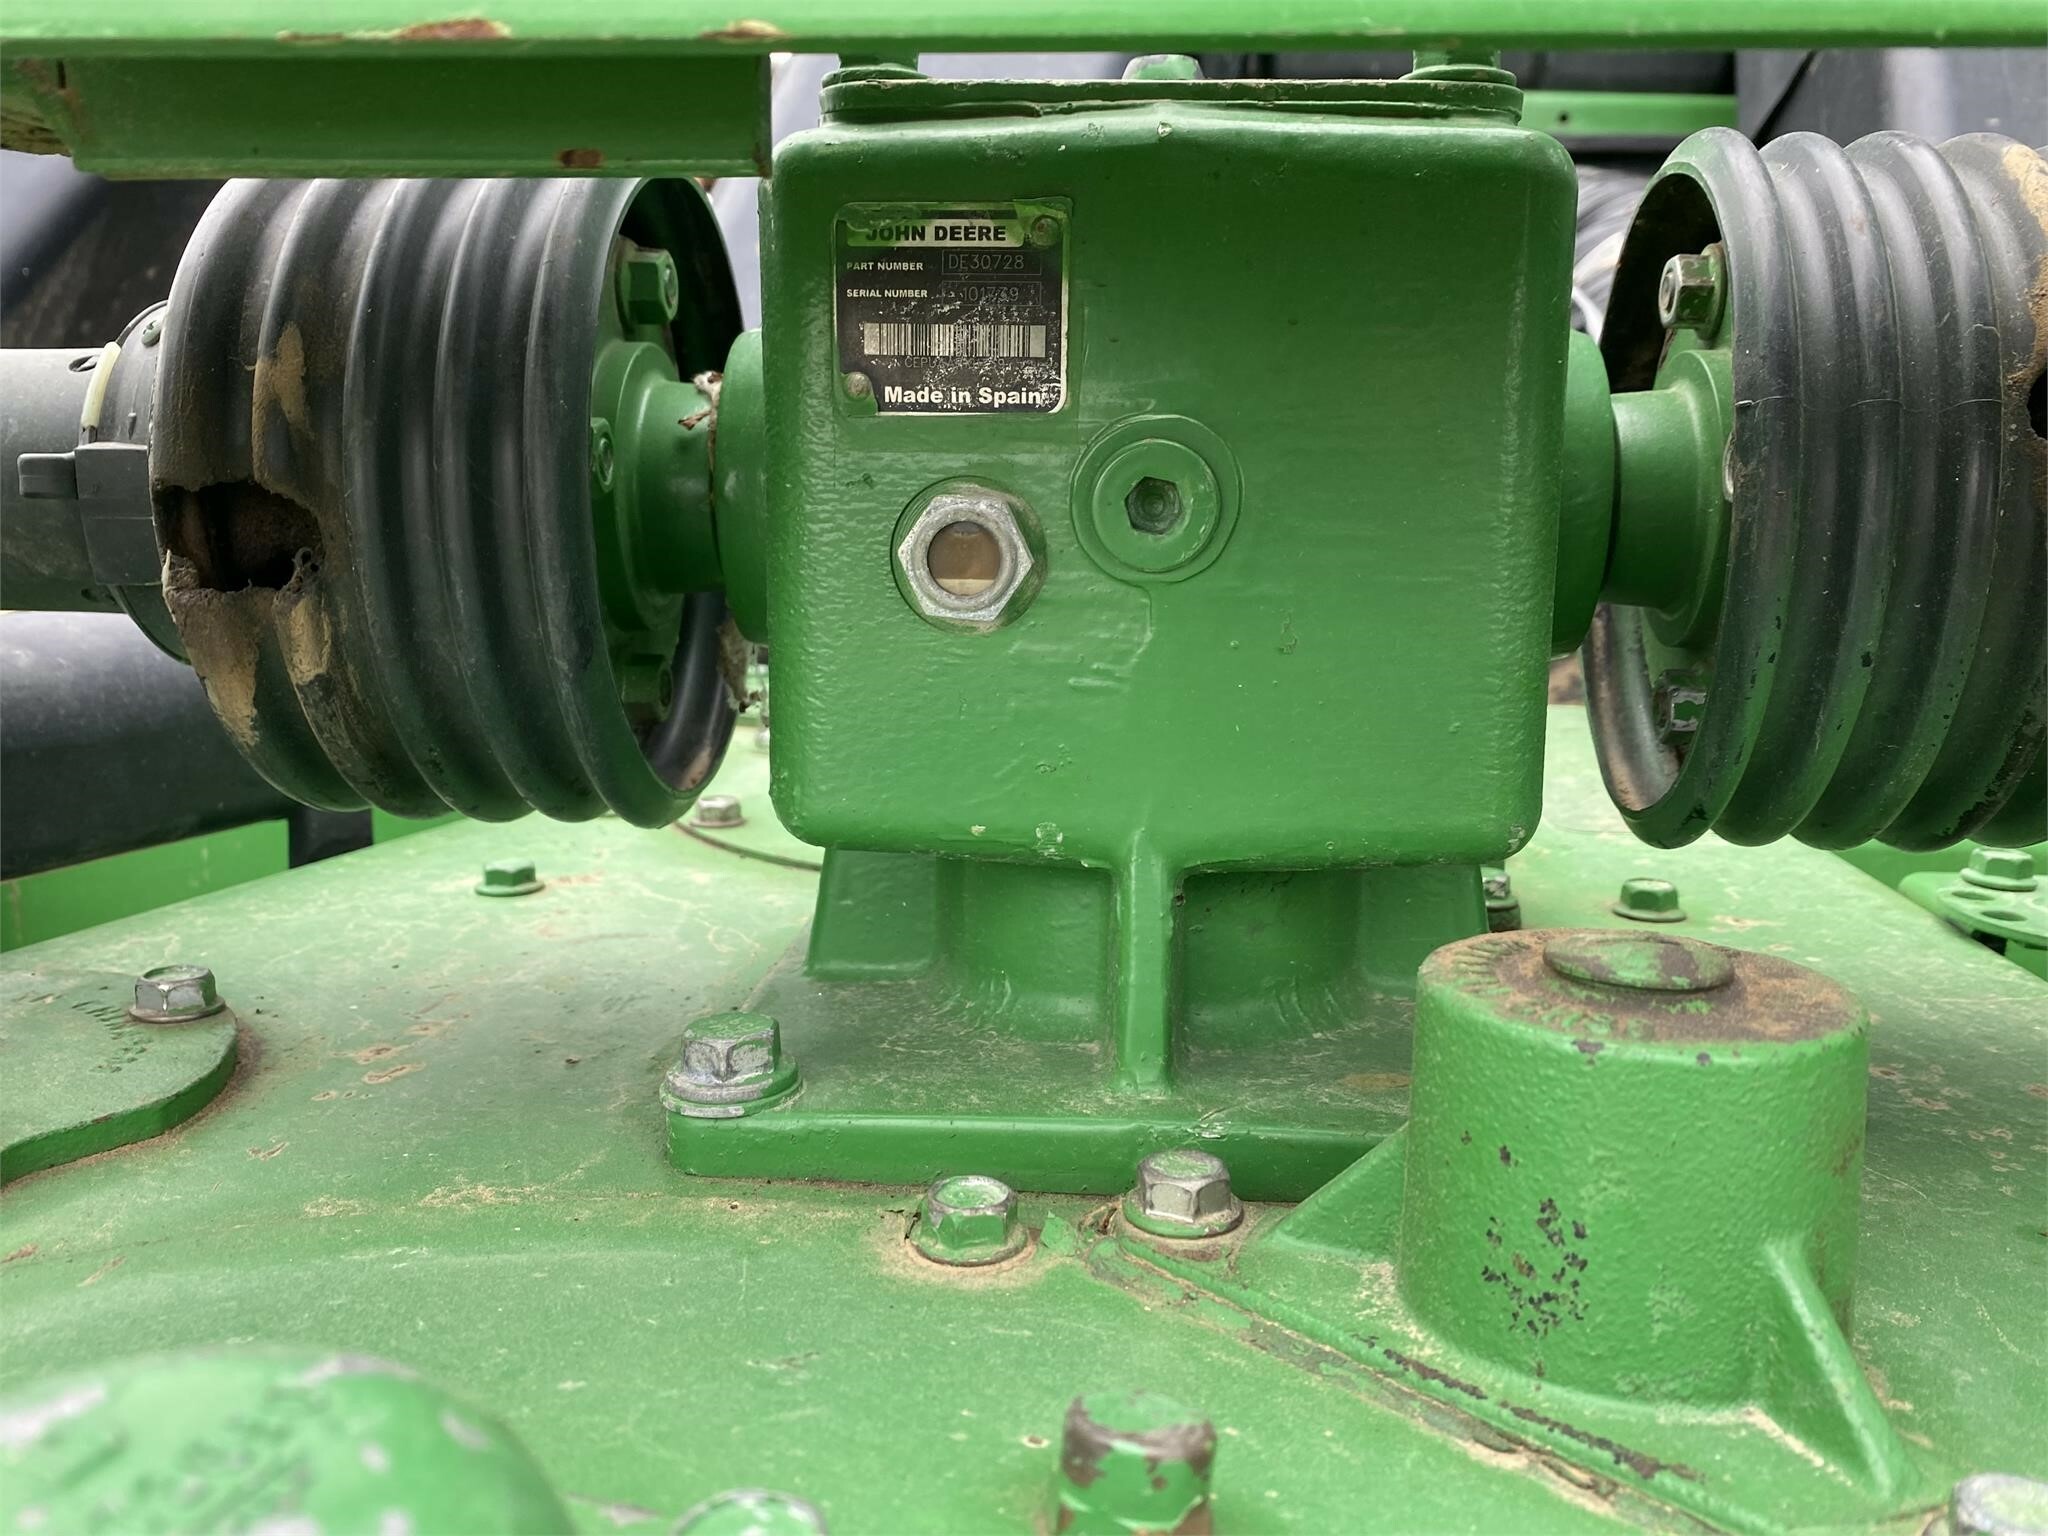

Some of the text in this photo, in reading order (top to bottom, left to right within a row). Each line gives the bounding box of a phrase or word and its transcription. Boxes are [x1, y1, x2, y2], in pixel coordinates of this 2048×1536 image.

[865, 225, 1006, 241] JOHN DEERE
[846, 254, 1025, 271] PART NUMBER DE30728
[846, 289, 882, 298] SERIAL
[884, 289, 928, 298] NUMBER
[884, 386, 1041, 408] Made in Spain
